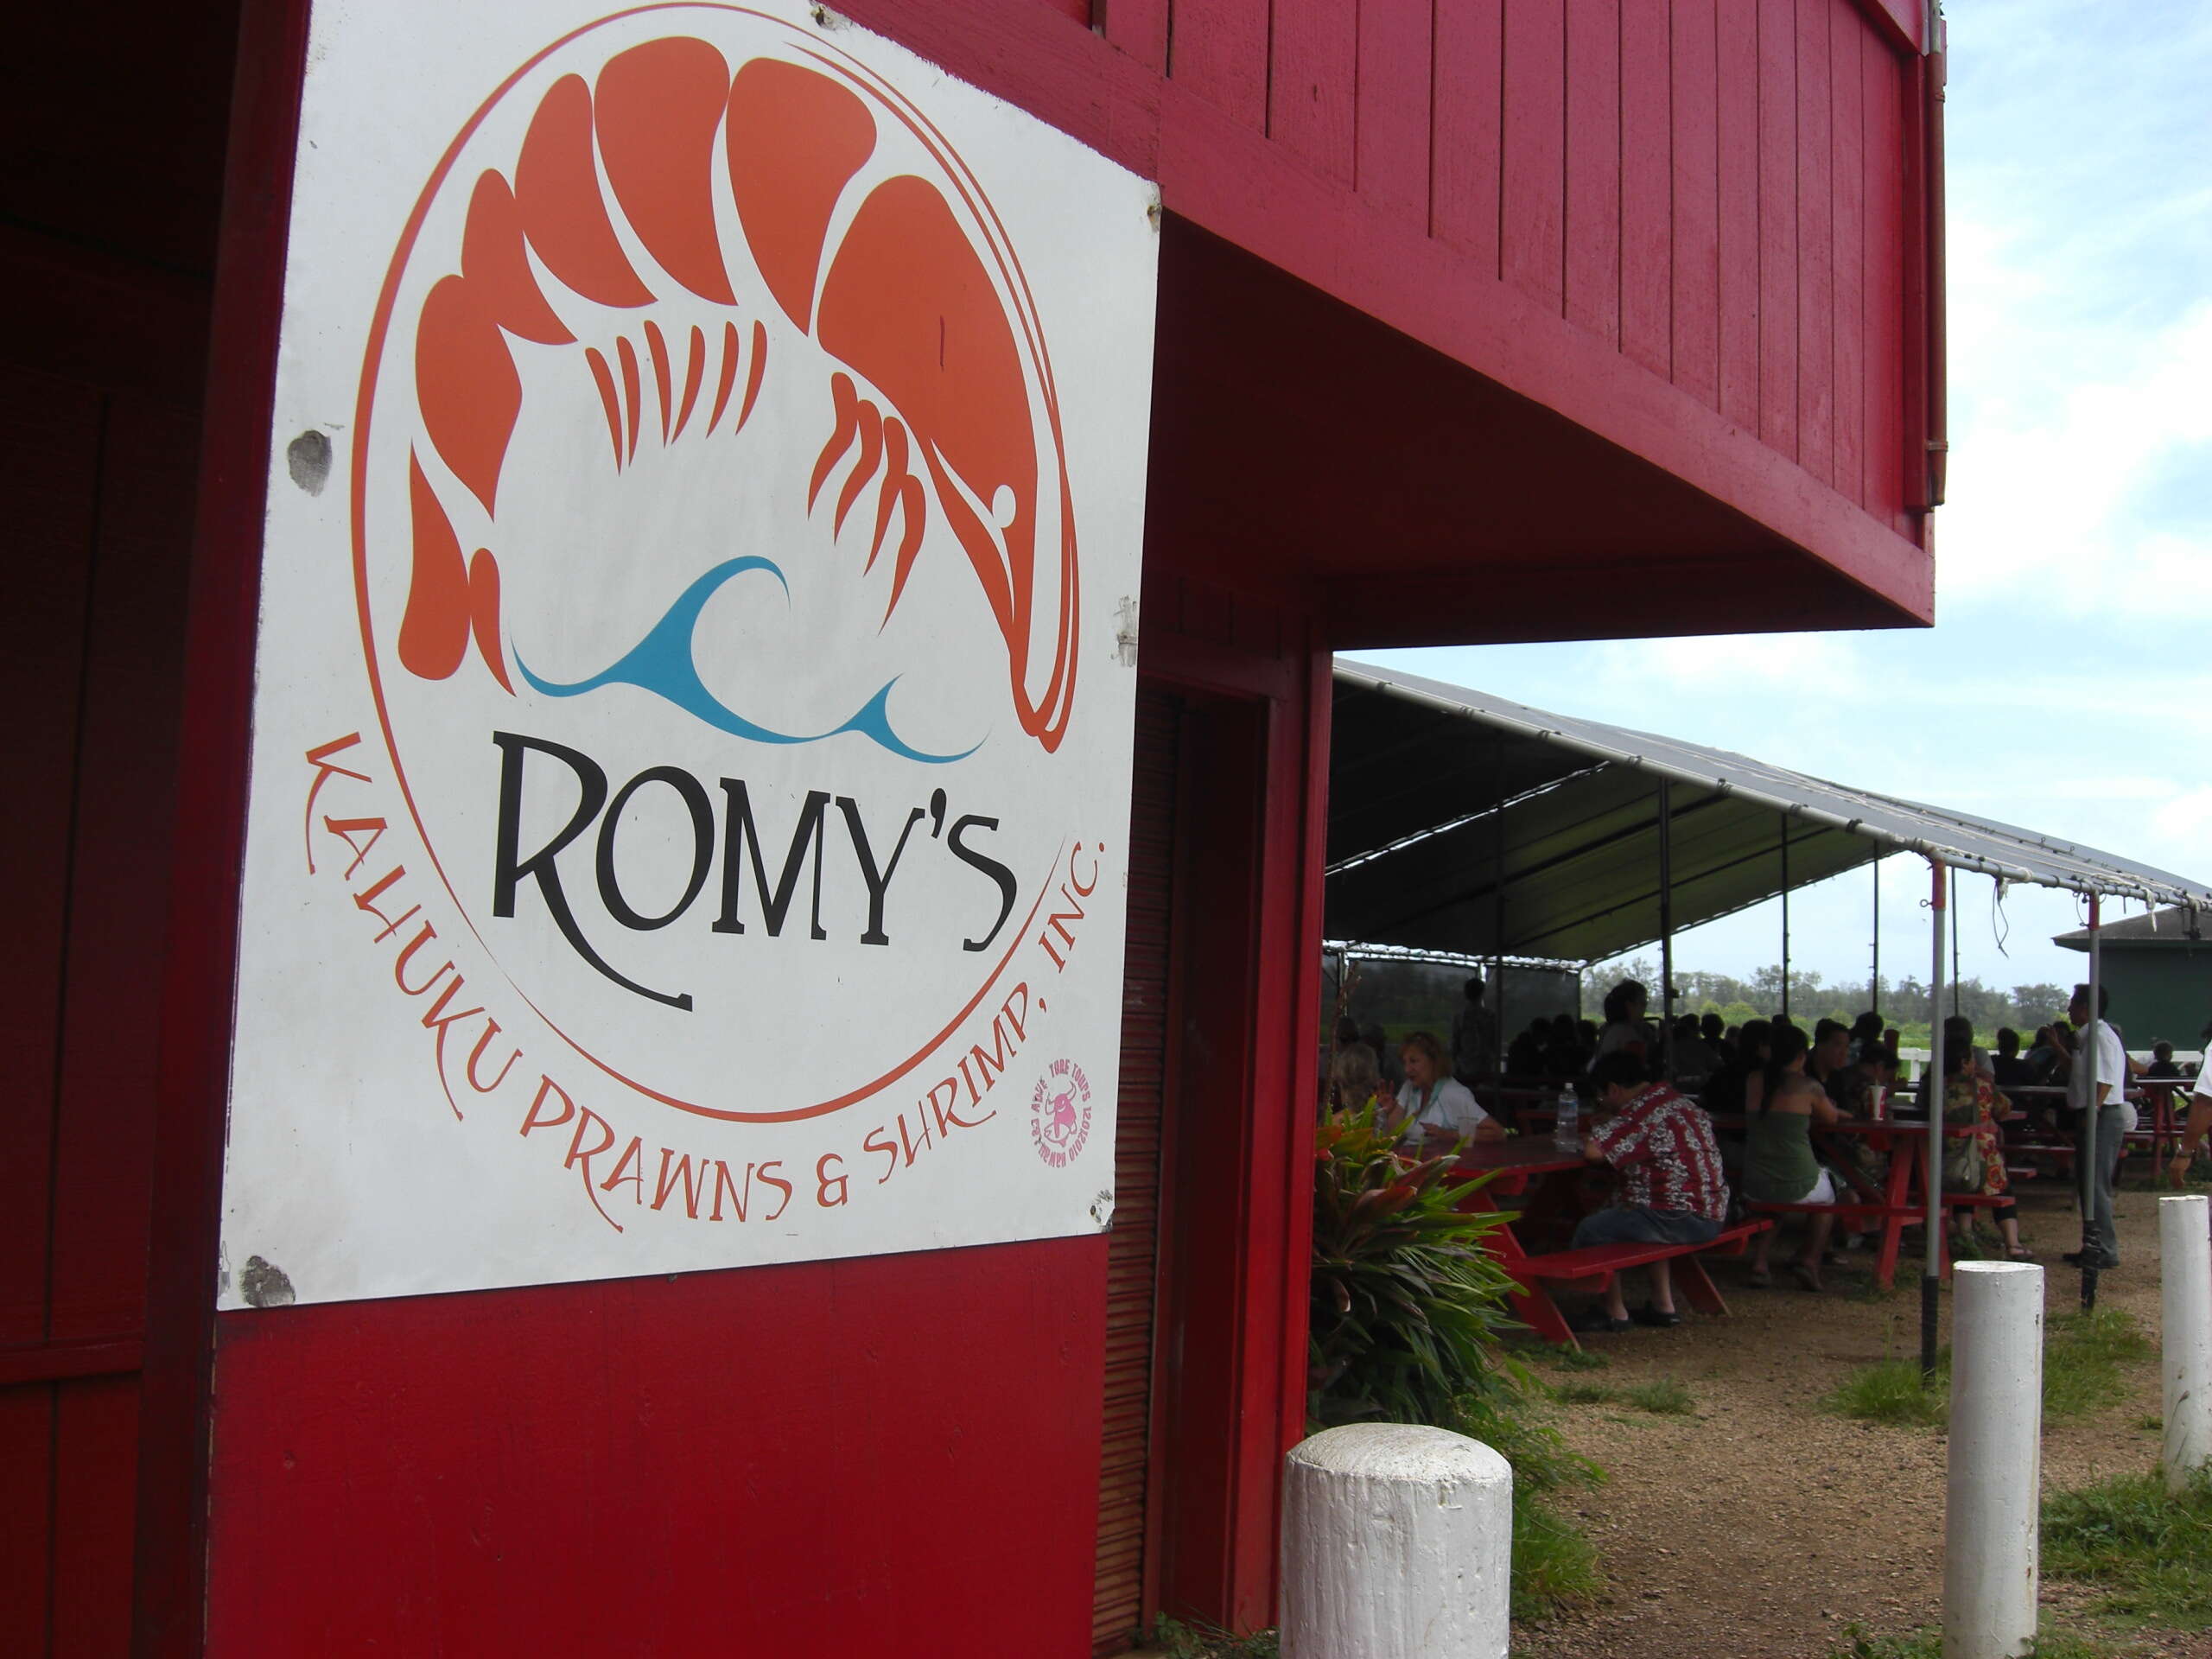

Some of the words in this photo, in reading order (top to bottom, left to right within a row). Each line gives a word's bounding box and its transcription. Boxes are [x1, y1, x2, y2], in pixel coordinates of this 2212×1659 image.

[305, 731, 523, 1122] KAHUKU
[519, 1074, 793, 1234] PRAWNS
[816, 1153, 849, 1208] &
[863, 981, 1048, 1185] SHRIMP,
[1038, 841, 1106, 974] INC.
[493, 731, 1017, 1012] ROMY'S
